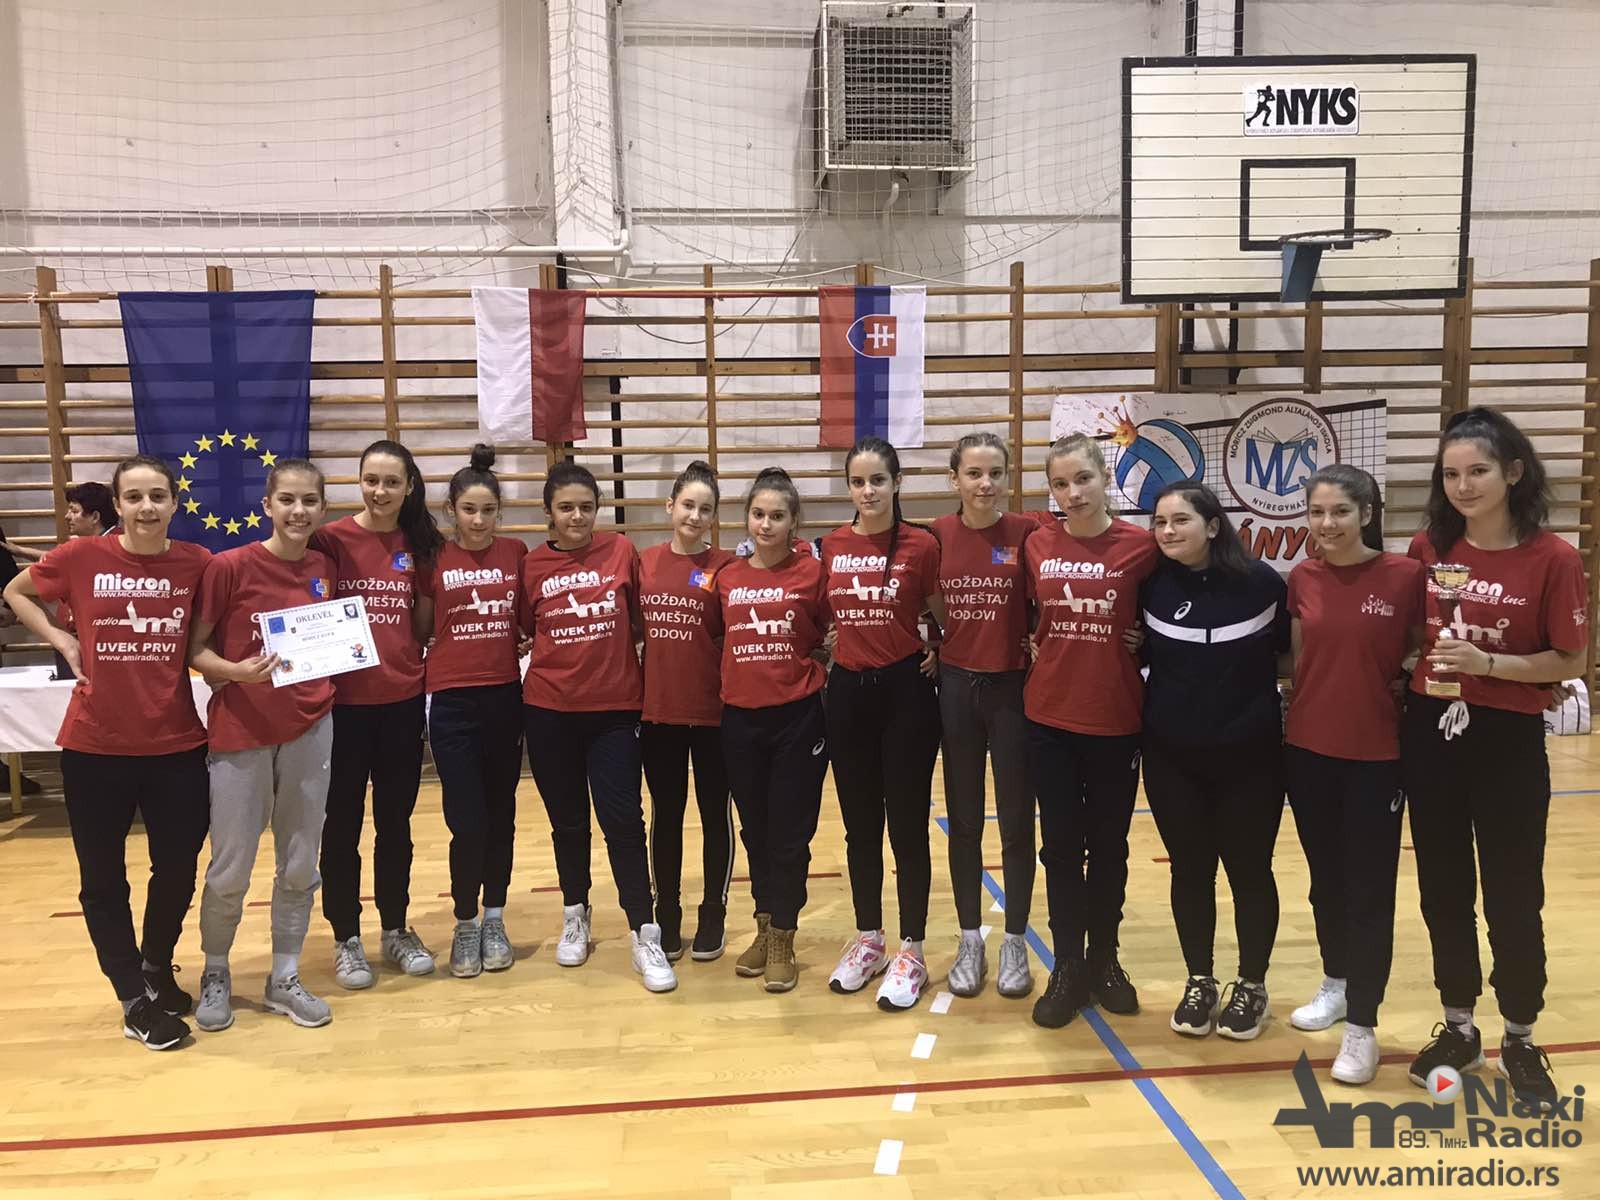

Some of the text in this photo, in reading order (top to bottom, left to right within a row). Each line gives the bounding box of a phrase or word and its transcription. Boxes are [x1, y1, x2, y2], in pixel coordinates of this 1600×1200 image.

[1276, 87, 1356, 125] NYKS
[1244, 406, 1283, 429] ZSIGMOND
[1320, 427, 1332, 454] ISKOLA
[1246, 437, 1317, 496] MZS
[1252, 497, 1306, 512] NYÍREGYHÁZ
[832, 554, 887, 569] Micron
[1040, 558, 1105, 573] Micron
[94, 573, 171, 591] Micron
[442, 568, 502, 585] Micron
[541, 571, 599, 595] Micron
[338, 578, 411, 593] GVOŽĐARA
[728, 587, 784, 601] Micron
[92, 617, 119, 626] radio
[367, 615, 400, 624] DOVI
[451, 621, 510, 634] UVEK PRVI
[551, 620, 616, 638] UVEK PRVI
[1081, 623, 1112, 634] PRVI
[96, 642, 176, 653] UVEK PRVI
[732, 644, 765, 655] UVEK
[736, 653, 792, 663] www.amiradio.rs
